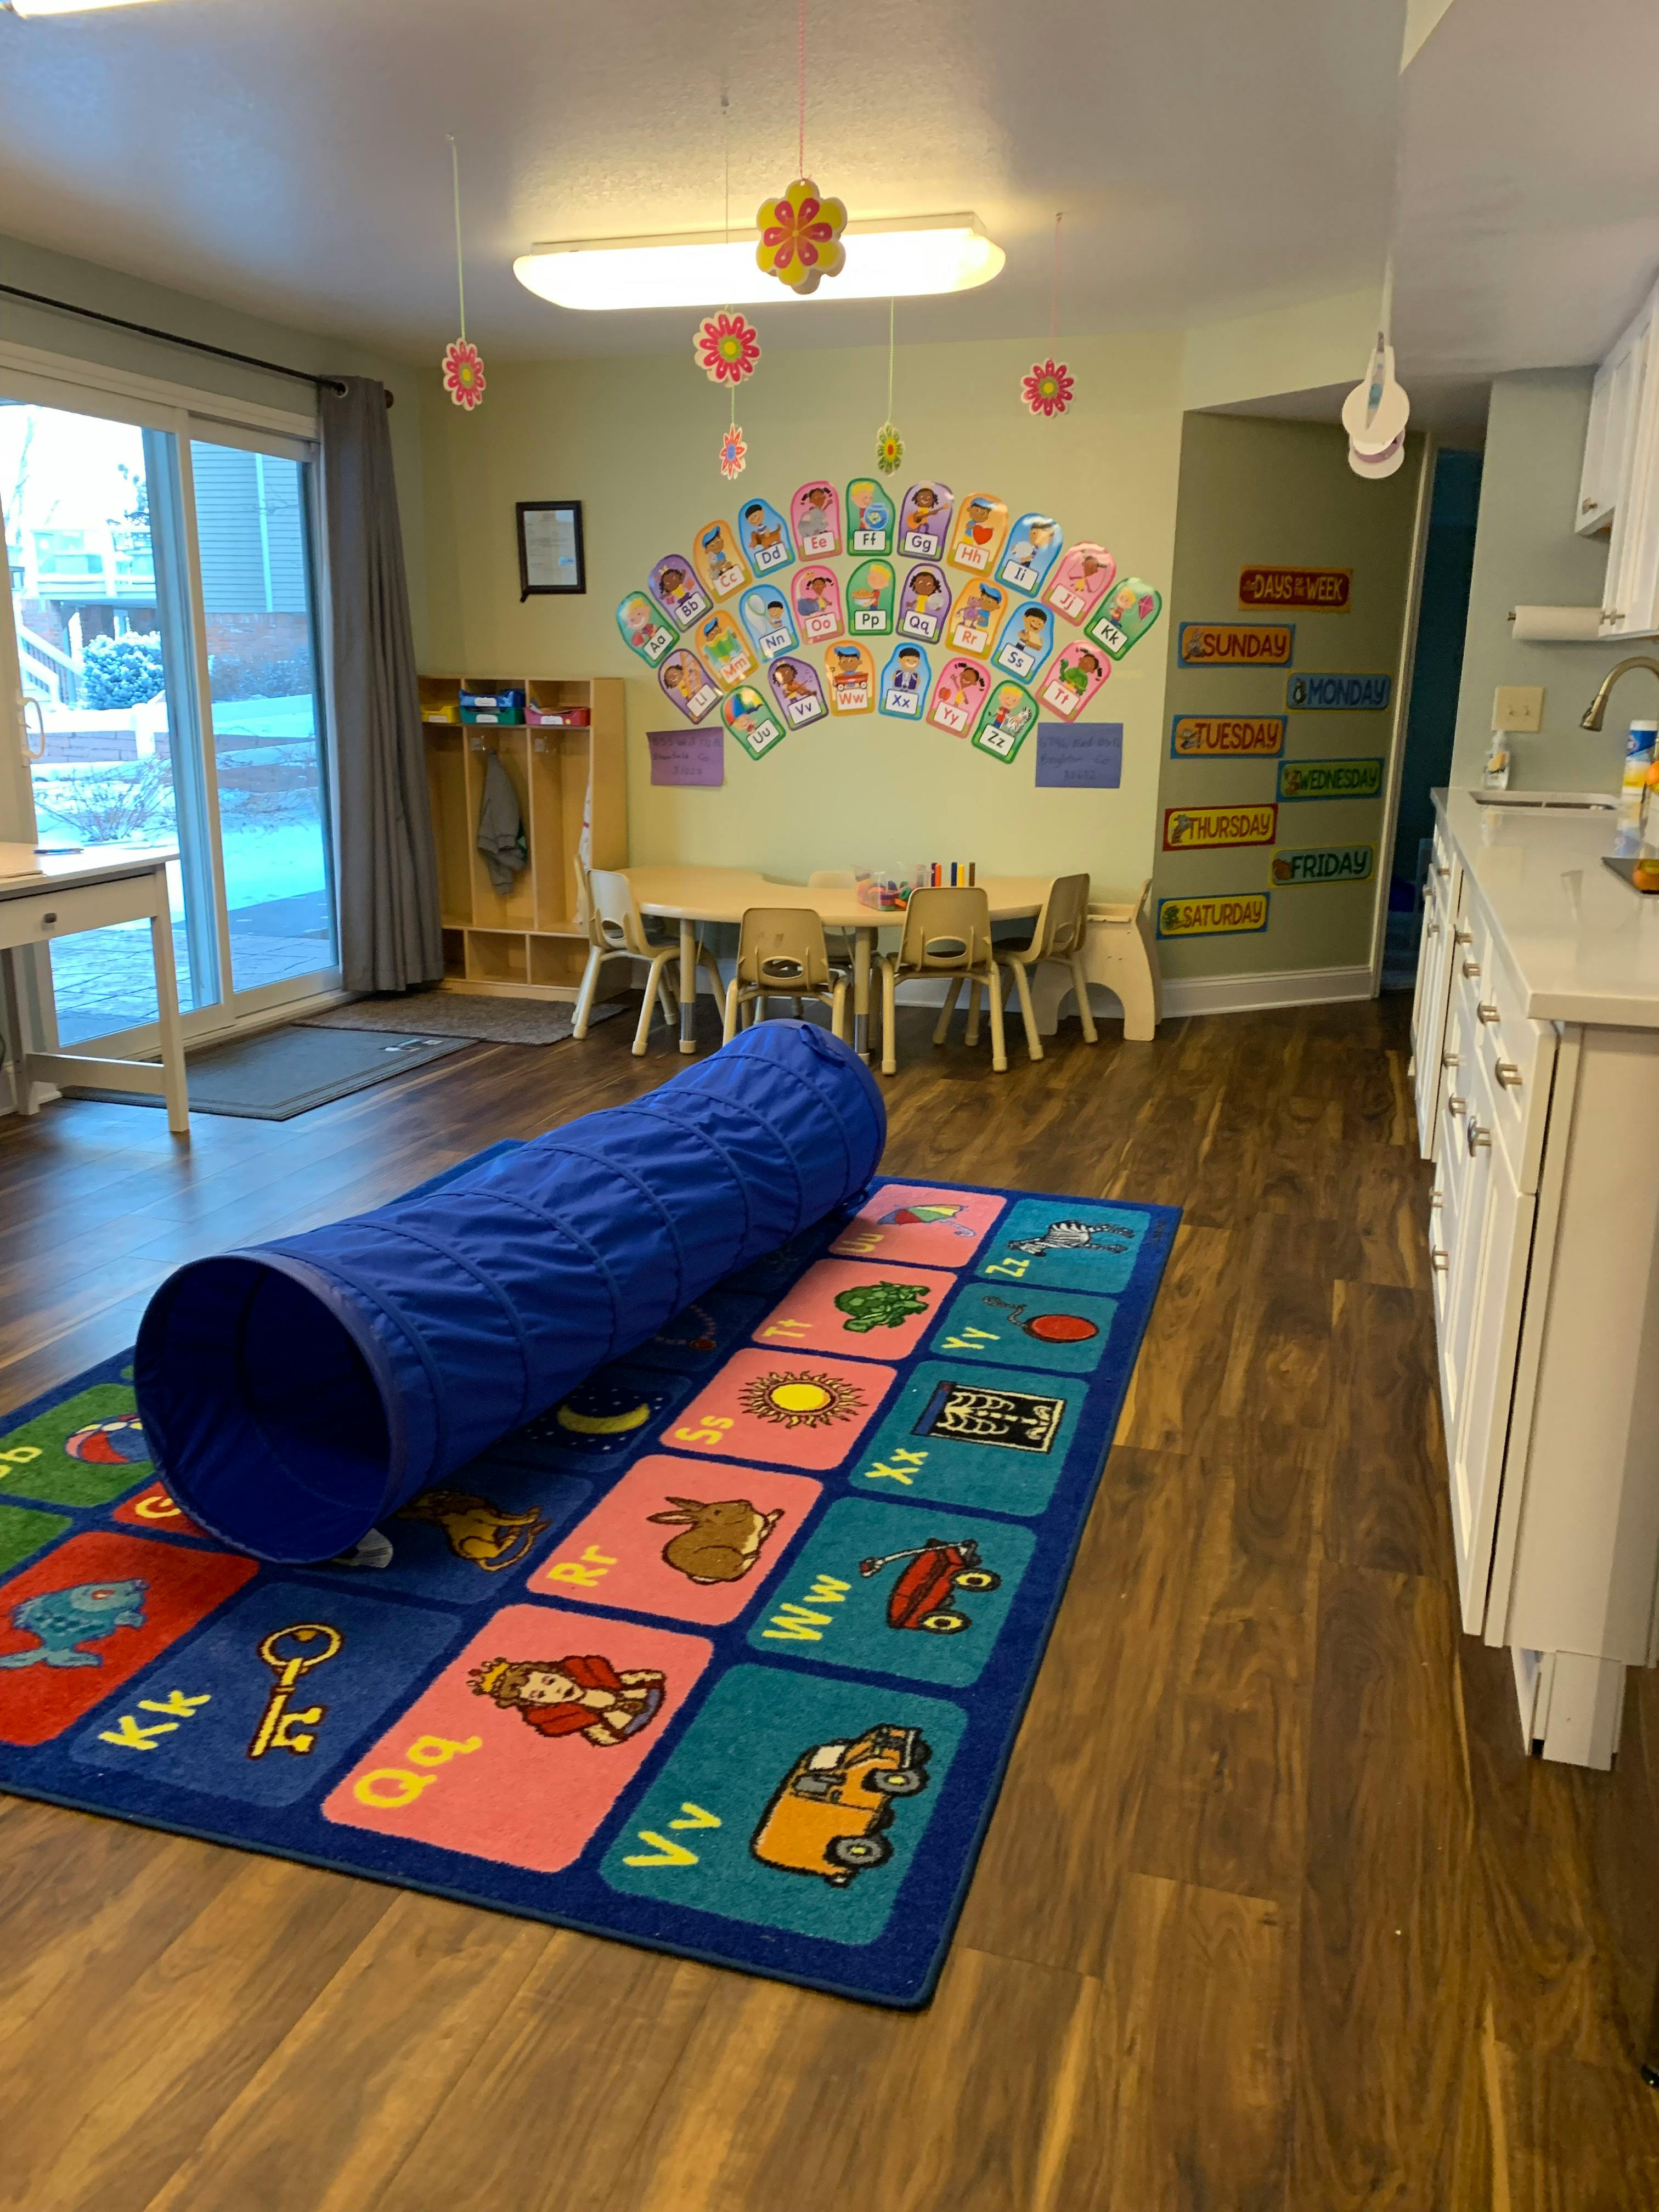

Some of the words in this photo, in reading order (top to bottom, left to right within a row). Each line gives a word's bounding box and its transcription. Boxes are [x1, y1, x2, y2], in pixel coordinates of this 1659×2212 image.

[811, 537, 827, 549] Ee
[863, 532, 876, 545] Ff
[912, 535, 932, 552] Gg
[761, 547, 781, 564] Dd
[962, 547, 981, 562] Hh
[720, 573, 737, 587] Cc
[1014, 567, 1027, 581] Ii
[1255, 574, 1292, 599] DAYS
[1306, 576, 1342, 601] WEEK
[682, 601, 698, 617] Bb
[1060, 594, 1075, 611] Jj
[812, 618, 831, 631] Oo
[862, 613, 879, 628] Pp
[910, 616, 929, 635] Qq
[650, 635, 666, 653] Aa
[766, 635, 785, 648] Nn
[962, 630, 978, 645] Rr
[1101, 625, 1119, 645] Kk
[1202, 631, 1288, 657] SUNDAY
[723, 658, 747, 677] Mm
[1008, 652, 1024, 668] Ss
[839, 693, 864, 705] Ww
[1054, 688, 1069, 705] Tt
[1306, 678, 1387, 706] MONDAY
[795, 702, 811, 715] Vv
[892, 695, 910, 708] Xx
[944, 708, 960, 725] Yy
[753, 727, 771, 744] Uu
[988, 731, 1006, 748] Zz
[1194, 722, 1279, 749] TUESDAY
[1299, 768, 1380, 791] WEDNESDAY
[1188, 814, 1271, 840] THURSDAY
[1290, 851, 1369, 877] FRIDAY
[1183, 901, 1262, 927] SATURDAY
[837, 1233, 884, 1252] Uu
[985, 1258, 1030, 1277] Zz
[761, 1319, 812, 1338] Tt
[941, 1327, 1000, 1349] Yy
[674, 1415, 734, 1445] Ss
[865, 1449, 928, 1484] Xx
[546, 1545, 618, 1586] Rr
[763, 1574, 851, 1640] Ww
[98, 1690, 211, 1750] Kk
[354, 1735, 483, 1808] Qq
[623, 1802, 721, 1866] Vv
